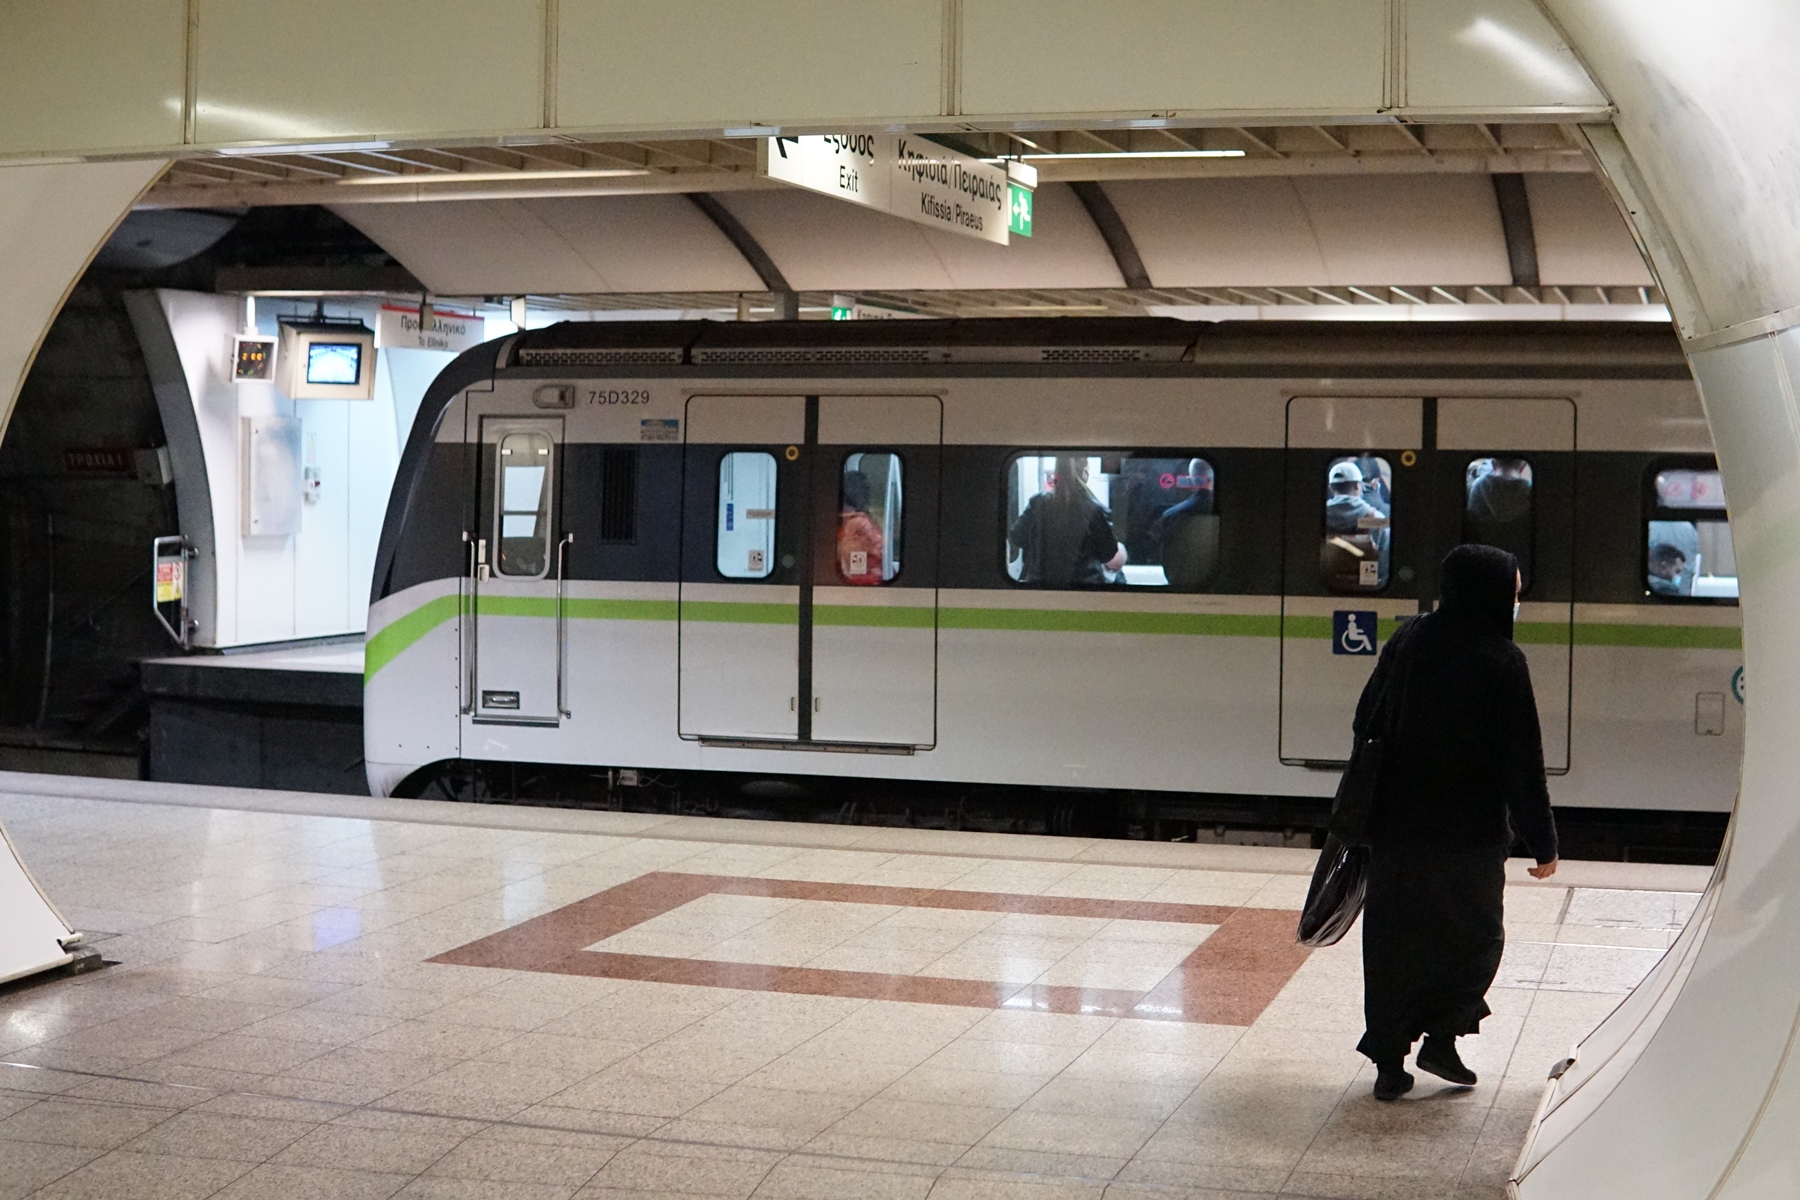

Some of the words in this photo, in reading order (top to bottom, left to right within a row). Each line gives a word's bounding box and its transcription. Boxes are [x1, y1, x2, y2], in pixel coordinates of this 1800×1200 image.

[840, 165, 858, 192] Exit
[401, 315, 423, 333] Προ
[588, 390, 650, 405] 75D329
